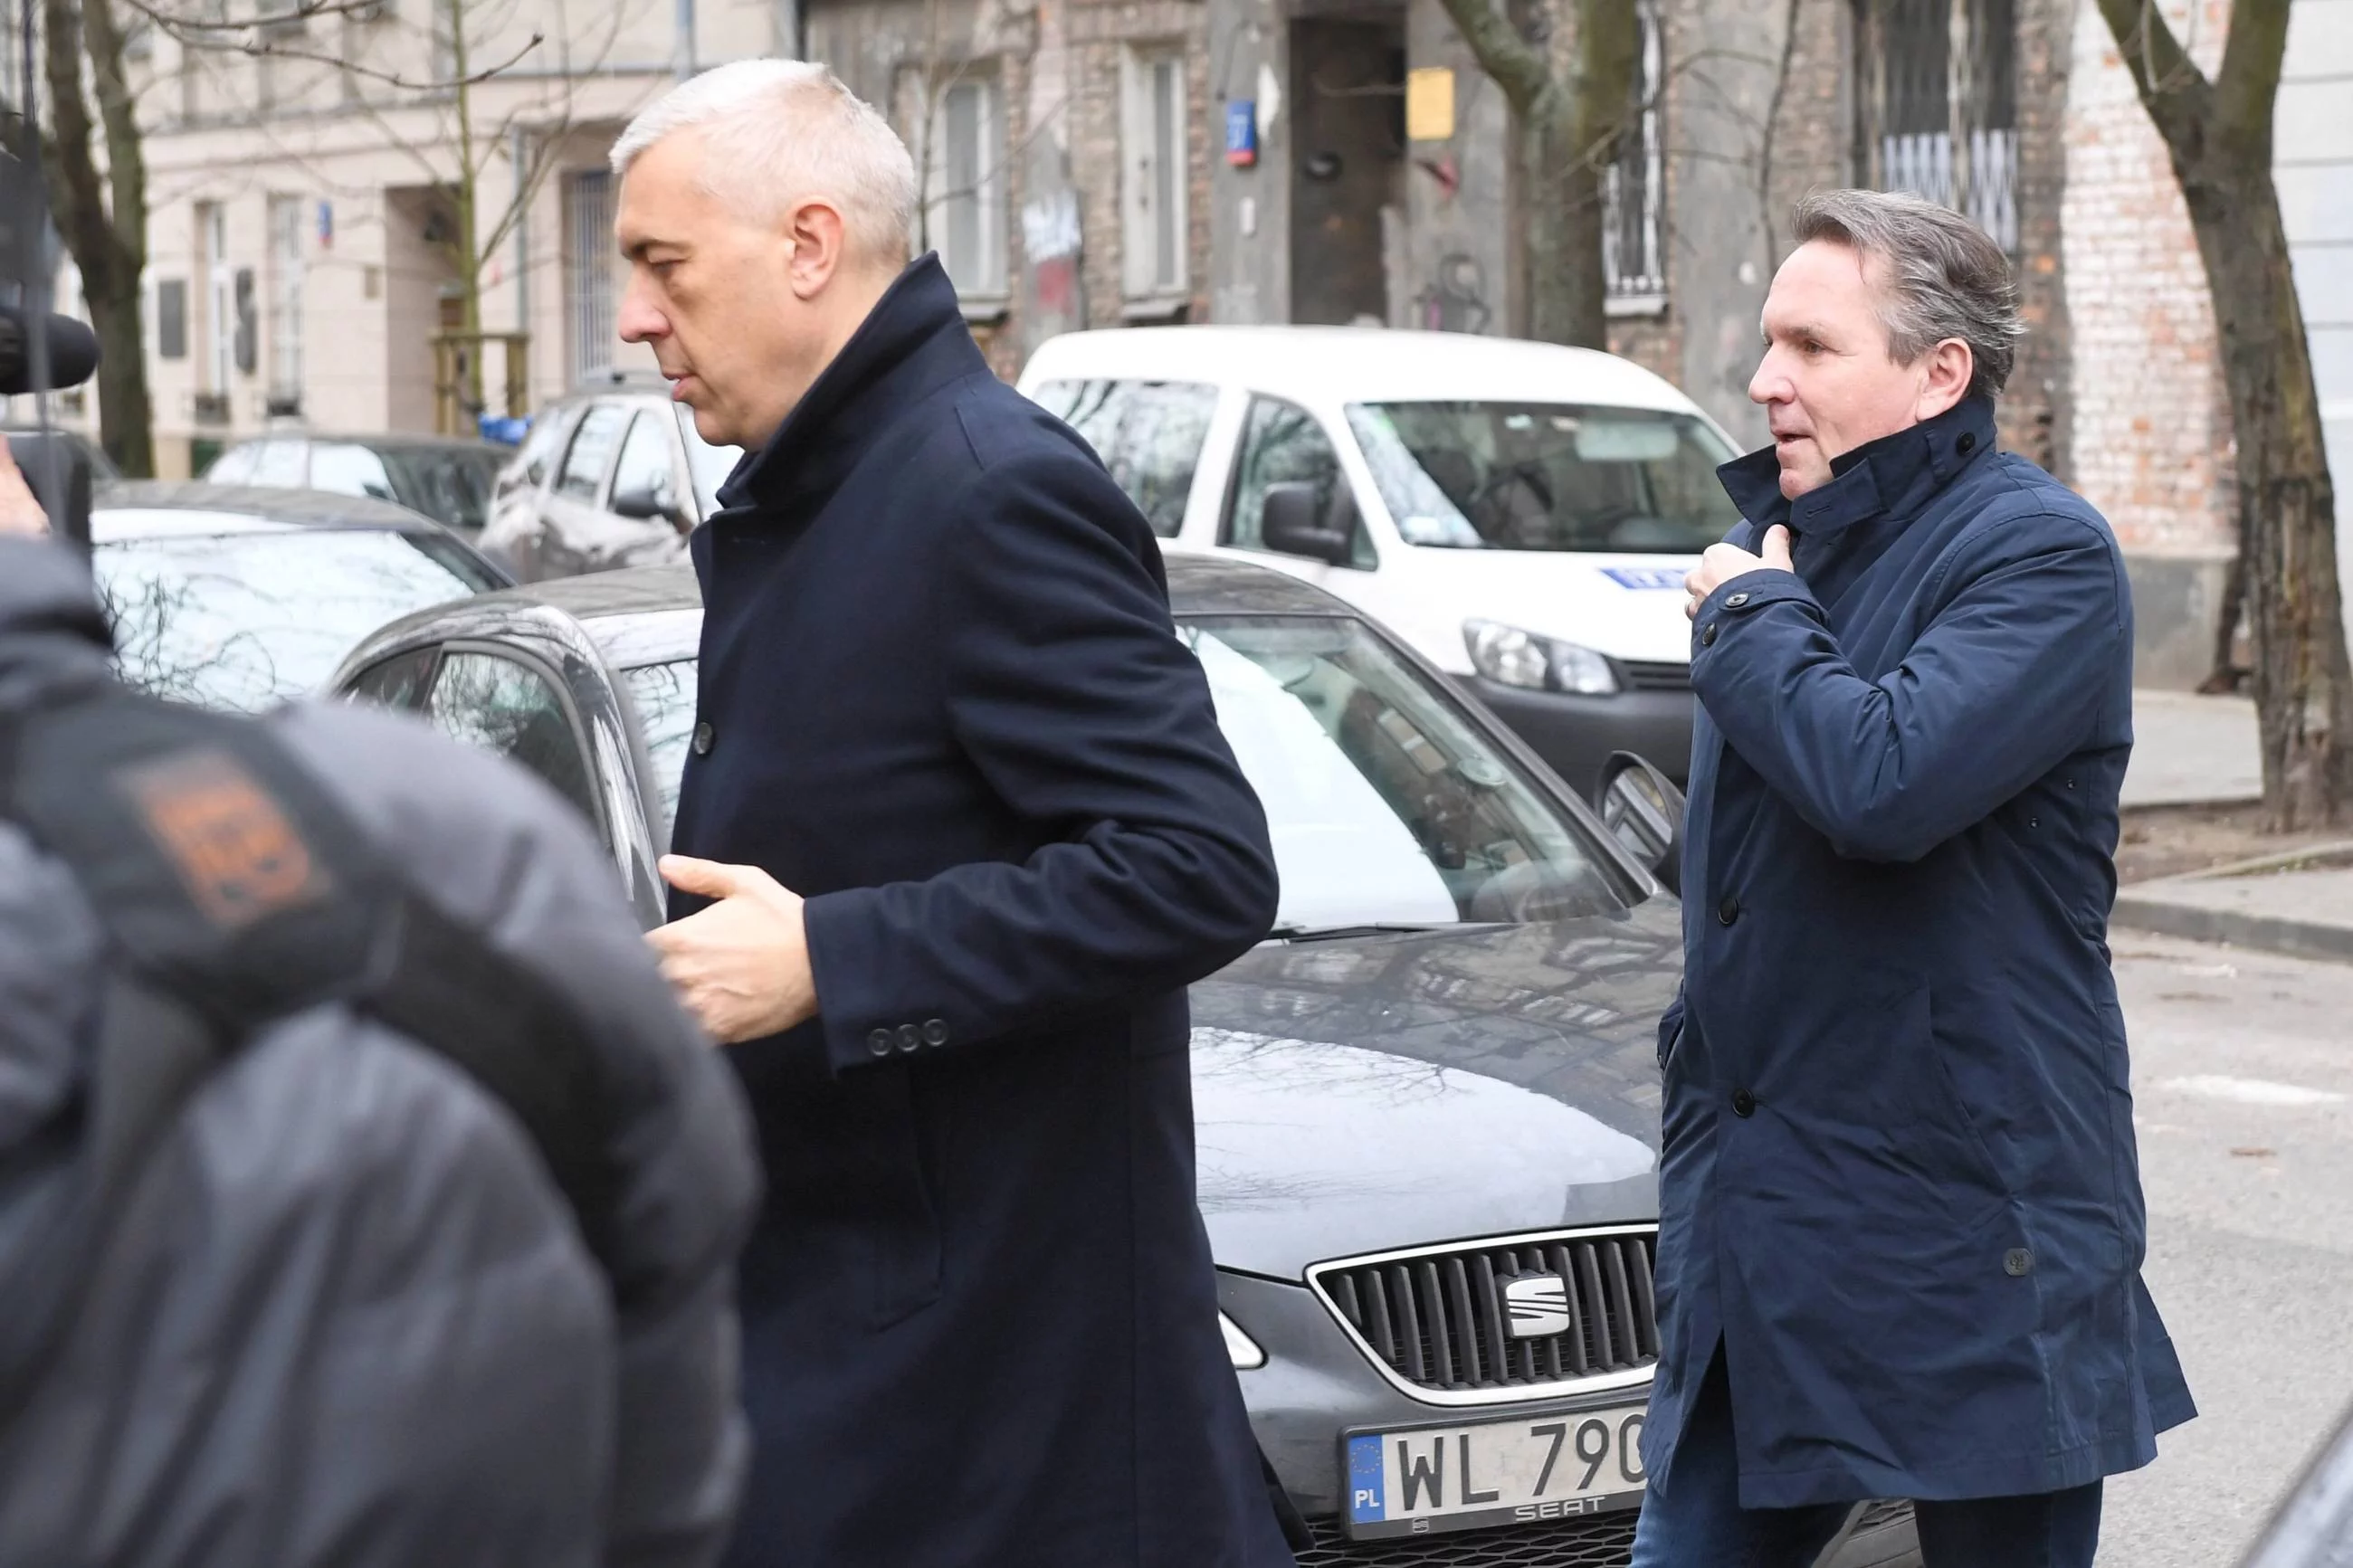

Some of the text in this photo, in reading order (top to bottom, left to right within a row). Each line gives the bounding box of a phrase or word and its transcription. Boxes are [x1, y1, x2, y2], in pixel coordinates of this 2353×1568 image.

[1397, 1413, 1647, 1511] WL 790
[1355, 1489, 1380, 1509] PL
[1515, 1497, 1605, 1521] SEAT
